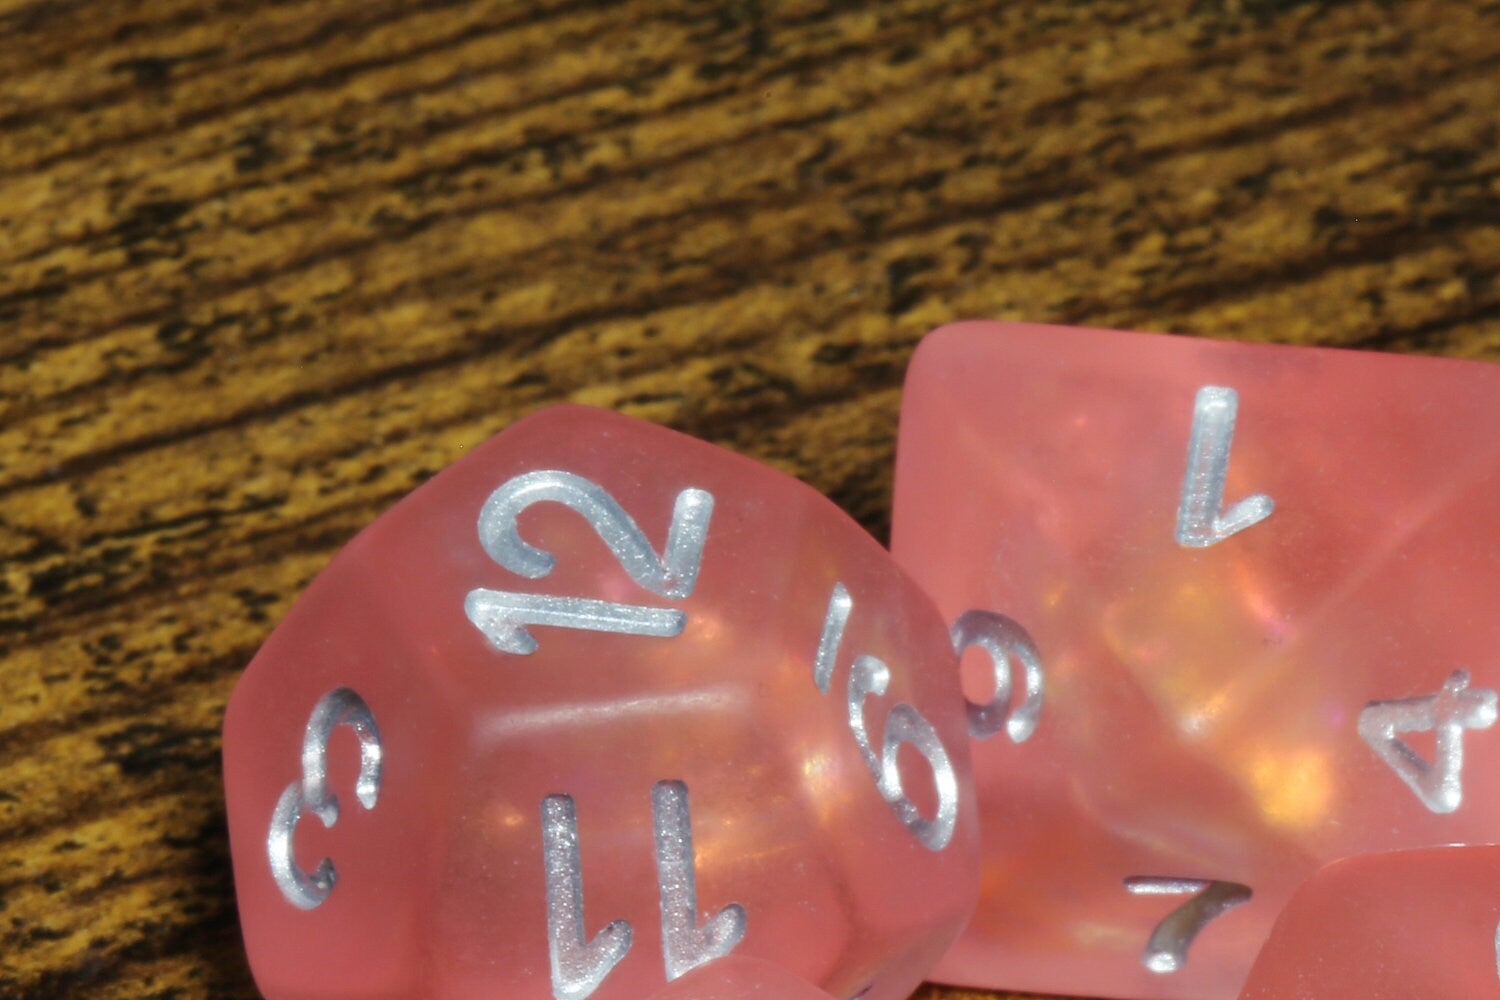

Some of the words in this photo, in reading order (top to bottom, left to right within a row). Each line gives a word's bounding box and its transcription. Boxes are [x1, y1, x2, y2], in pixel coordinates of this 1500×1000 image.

[1175, 385, 1275, 548] 1
[464, 470, 714, 655] 12
[267, 686, 383, 909] 3
[1358, 668, 1498, 814] 4
[1122, 875, 1253, 973] 7
